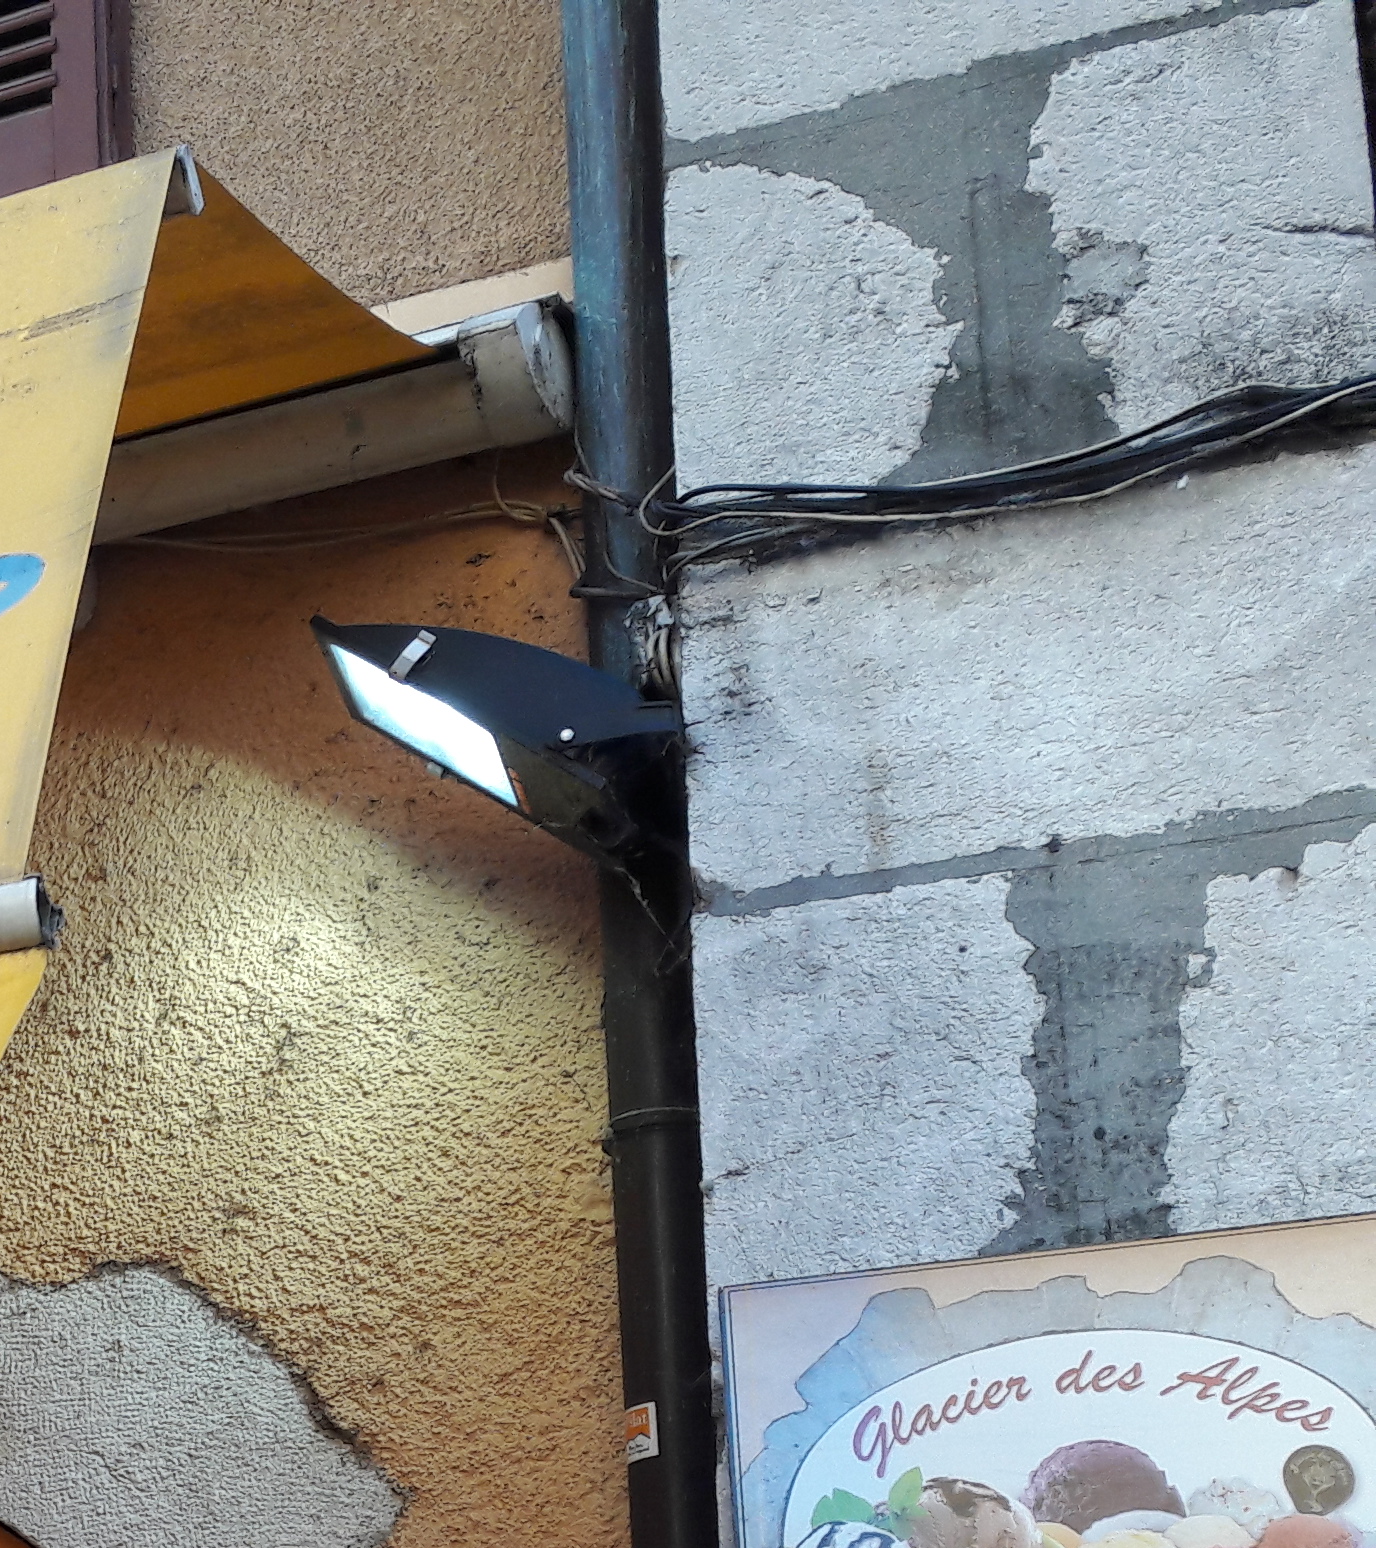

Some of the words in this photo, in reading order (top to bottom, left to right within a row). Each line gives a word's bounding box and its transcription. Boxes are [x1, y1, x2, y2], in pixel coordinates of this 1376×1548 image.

[852, 1376, 1032, 1479] Glacier
[1055, 1349, 1145, 1394] des
[1160, 1355, 1335, 1432] Alpes
